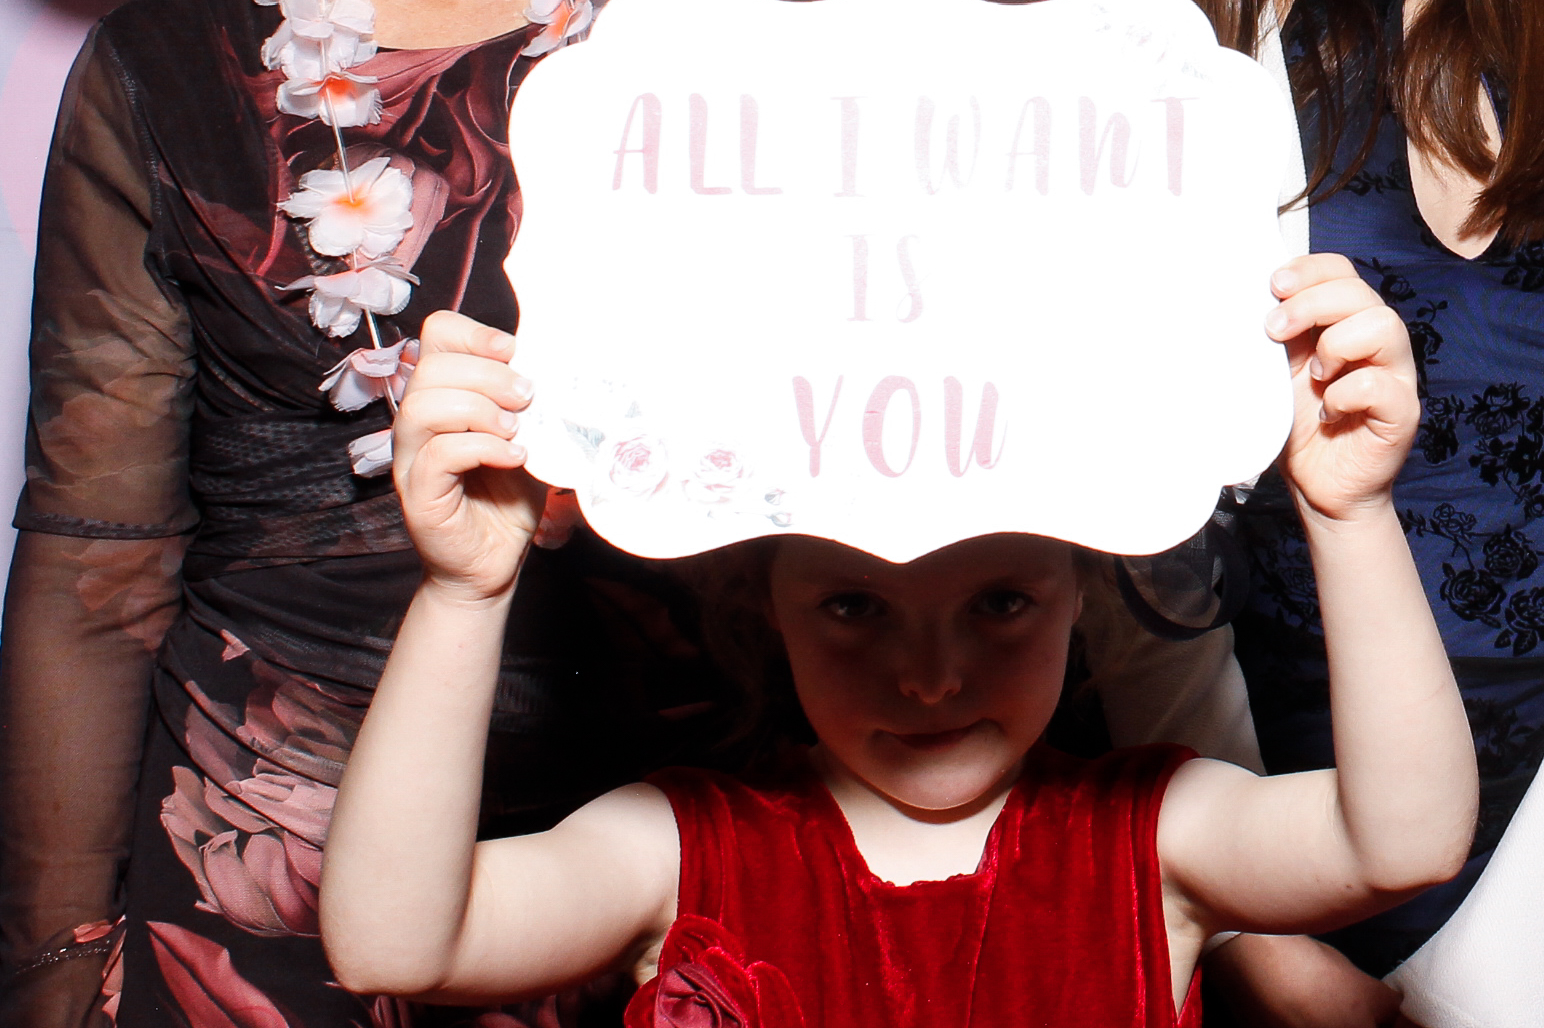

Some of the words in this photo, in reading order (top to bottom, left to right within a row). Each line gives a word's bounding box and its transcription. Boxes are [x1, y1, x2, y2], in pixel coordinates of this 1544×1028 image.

[612, 92, 784, 196] ALL
[830, 95, 868, 198] I
[914, 94, 1200, 197] WANT
[845, 234, 932, 324] IS
[791, 375, 1009, 479] YOU
